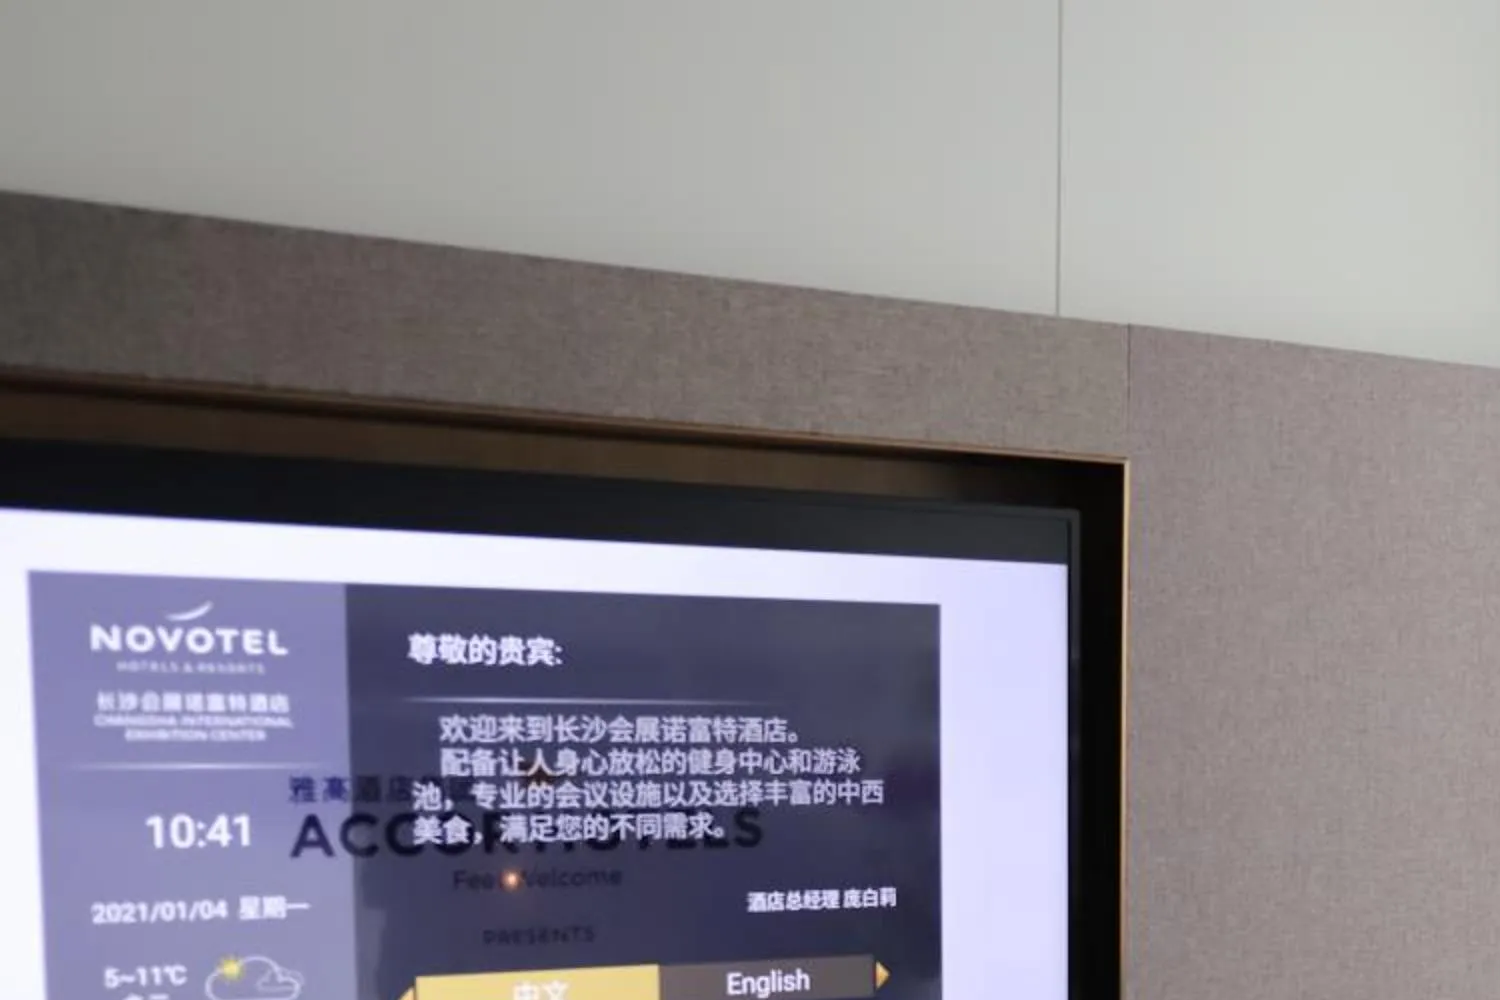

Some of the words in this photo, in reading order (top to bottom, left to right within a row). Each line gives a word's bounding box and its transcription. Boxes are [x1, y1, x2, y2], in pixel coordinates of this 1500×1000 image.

[90, 624, 289, 656] NOVOTEL
[408, 632, 563, 667] 尊敬的贵宾:
[439, 714, 798, 744] 欢迎来到长沙会展诺富特酒店。
[440, 747, 861, 778] 配备让人身心放松的健身中心和游泳
[145, 813, 251, 849] 10:41
[451, 869, 503, 891] Fee
[91, 898, 229, 925] 2021/01/04
[238, 895, 310, 921] 星期一
[747, 890, 841, 913] 酒店总经理
[726, 967, 811, 998] English
